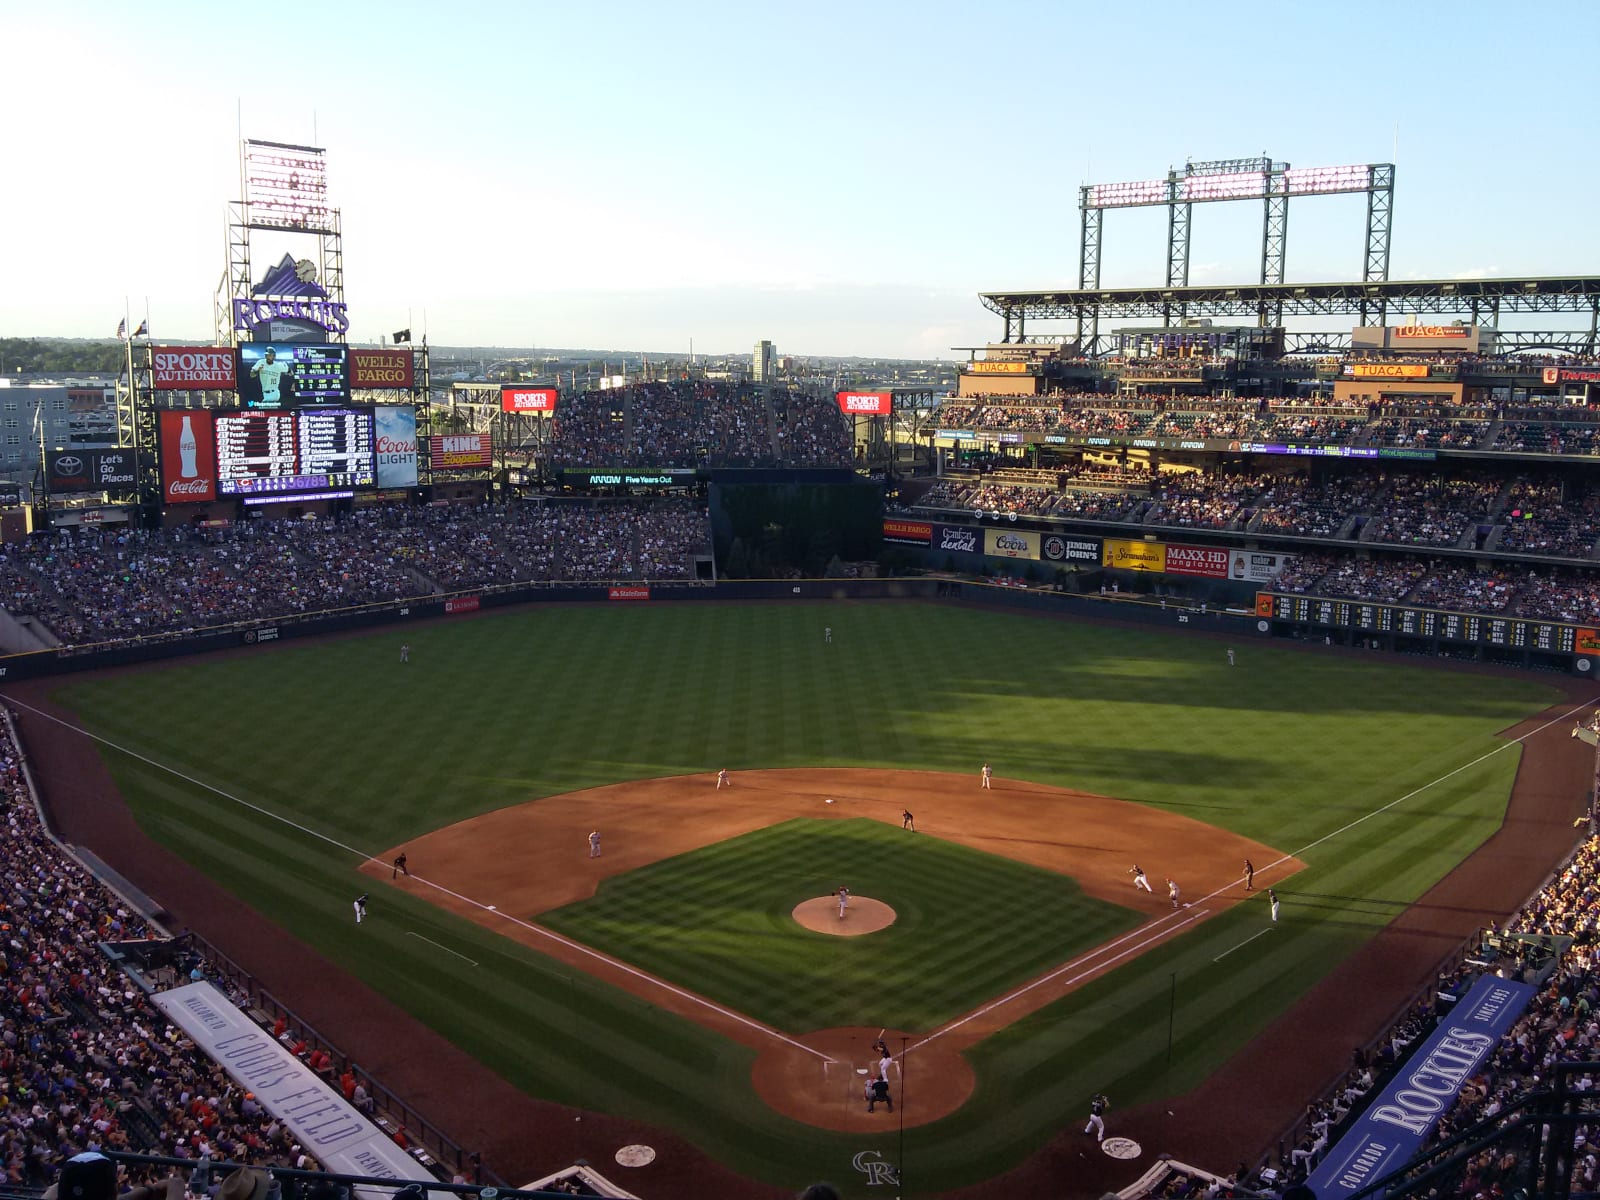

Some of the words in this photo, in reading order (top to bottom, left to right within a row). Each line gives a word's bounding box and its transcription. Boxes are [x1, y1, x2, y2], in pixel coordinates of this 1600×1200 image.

[233, 298, 350, 334] ROCKIES
[1398, 326, 1444, 336] TUACA
[1114, 334, 1141, 348] THE
[155, 354, 232, 370] SPORTS
[355, 356, 406, 368] WELLS
[356, 370, 406, 381] FARGO
[1361, 367, 1403, 375] TUACA
[514, 393, 546, 402] SPORTS
[846, 396, 879, 404] SPORTS
[375, 436, 416, 453] Coors
[442, 436, 481, 452] KING
[100, 455, 123, 464] Let's
[380, 454, 413, 464] LIGHT
[102, 474, 134, 482] Places
[590, 475, 621, 484] ARROW
[170, 480, 209, 494] Coca-Cola
[941, 538, 976, 551] dental
[996, 535, 1028, 551] Coors
[1066, 541, 1098, 550] JIMMY
[1066, 550, 1098, 560] JOHN'S
[1116, 548, 1159, 561] Stranahan's
[1168, 548, 1205, 561] MAXX
[1208, 551, 1226, 562] HD
[1167, 559, 1226, 569] sunglasses
[1474, 1003, 1499, 1021] SINCE
[1489, 989, 1510, 1004] 1993
[184, 998, 218, 1022] WELCOME
[210, 1020, 226, 1030] TO
[1370, 1026, 1494, 1136] ROCKIES
[215, 1033, 302, 1089] COORS
[272, 1086, 364, 1145] FIELD
[1339, 1142, 1387, 1189] COLORADO
